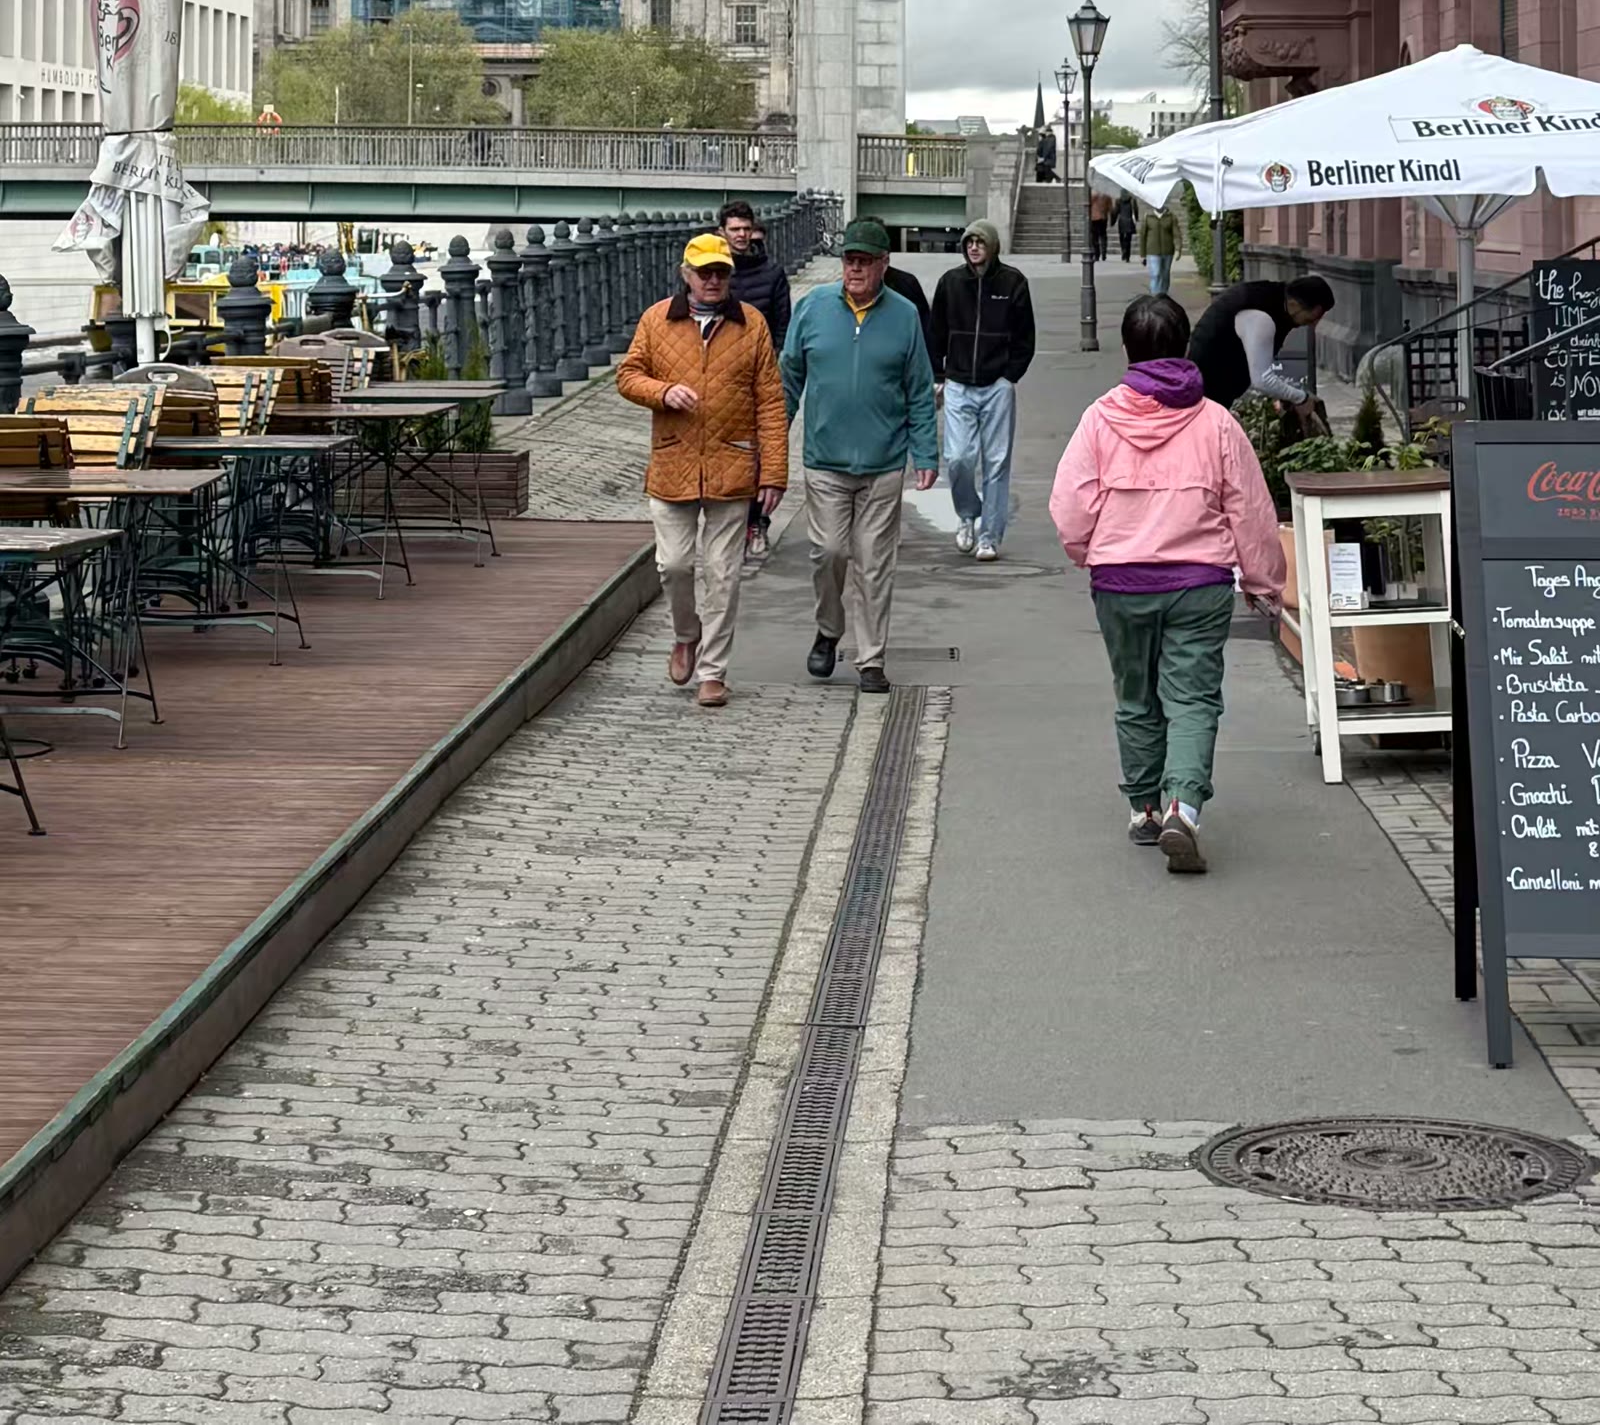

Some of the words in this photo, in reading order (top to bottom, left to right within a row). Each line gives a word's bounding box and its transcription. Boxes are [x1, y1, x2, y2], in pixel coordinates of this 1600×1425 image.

[41, 67, 84, 87] HUMBOLDT
[1412, 118, 1531, 138] Berliner
[1307, 159, 1395, 187] Berliner
[1399, 158, 1461, 182] Kindl
[1535, 269, 1564, 300] the
[1550, 371, 1566, 387] is
[1525, 565, 1571, 598] Tages
[1528, 639, 1573, 665] Salat
[1506, 671, 1589, 694] Bruschetta
[1511, 699, 1551, 723] Pasta
[1511, 737, 1560, 768] Pizza
[1510, 866, 1584, 890] Cannelloni
